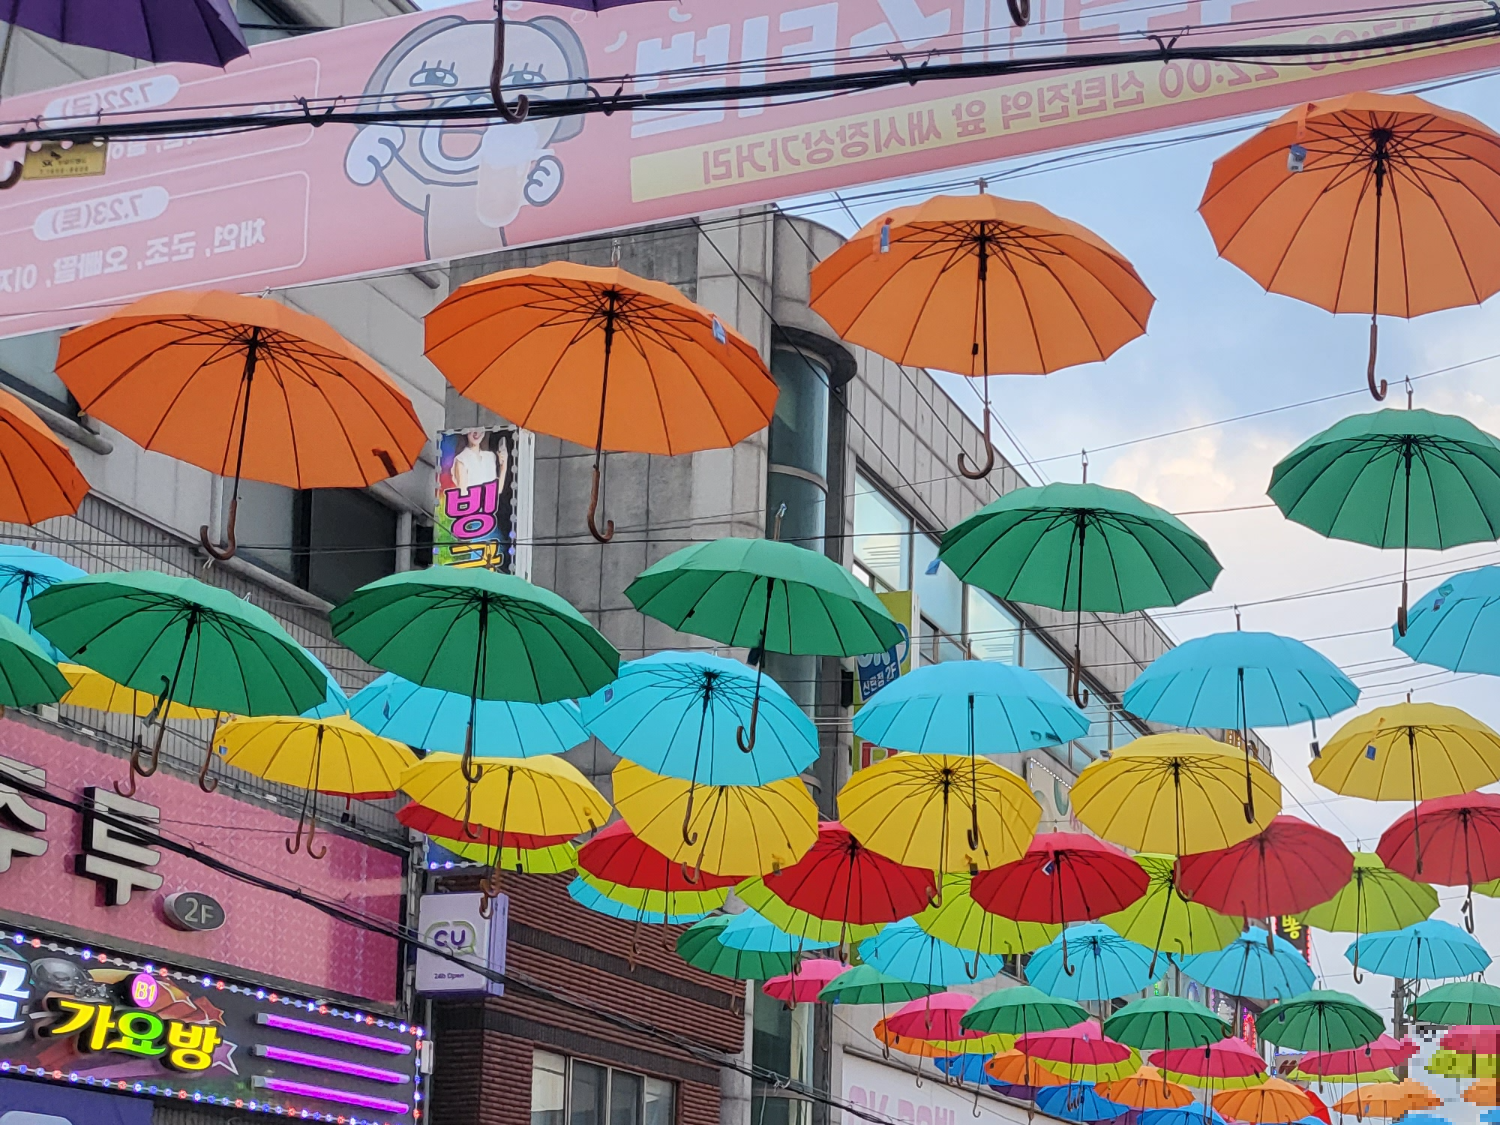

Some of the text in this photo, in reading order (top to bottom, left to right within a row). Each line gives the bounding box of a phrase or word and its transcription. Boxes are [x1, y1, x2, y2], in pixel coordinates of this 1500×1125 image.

[185, 897, 215, 925] 2F
[433, 929, 466, 947] CU
[447, 972, 465, 980] Open
[134, 980, 157, 1001] B1
[51, 1000, 222, 1071] 가요방
